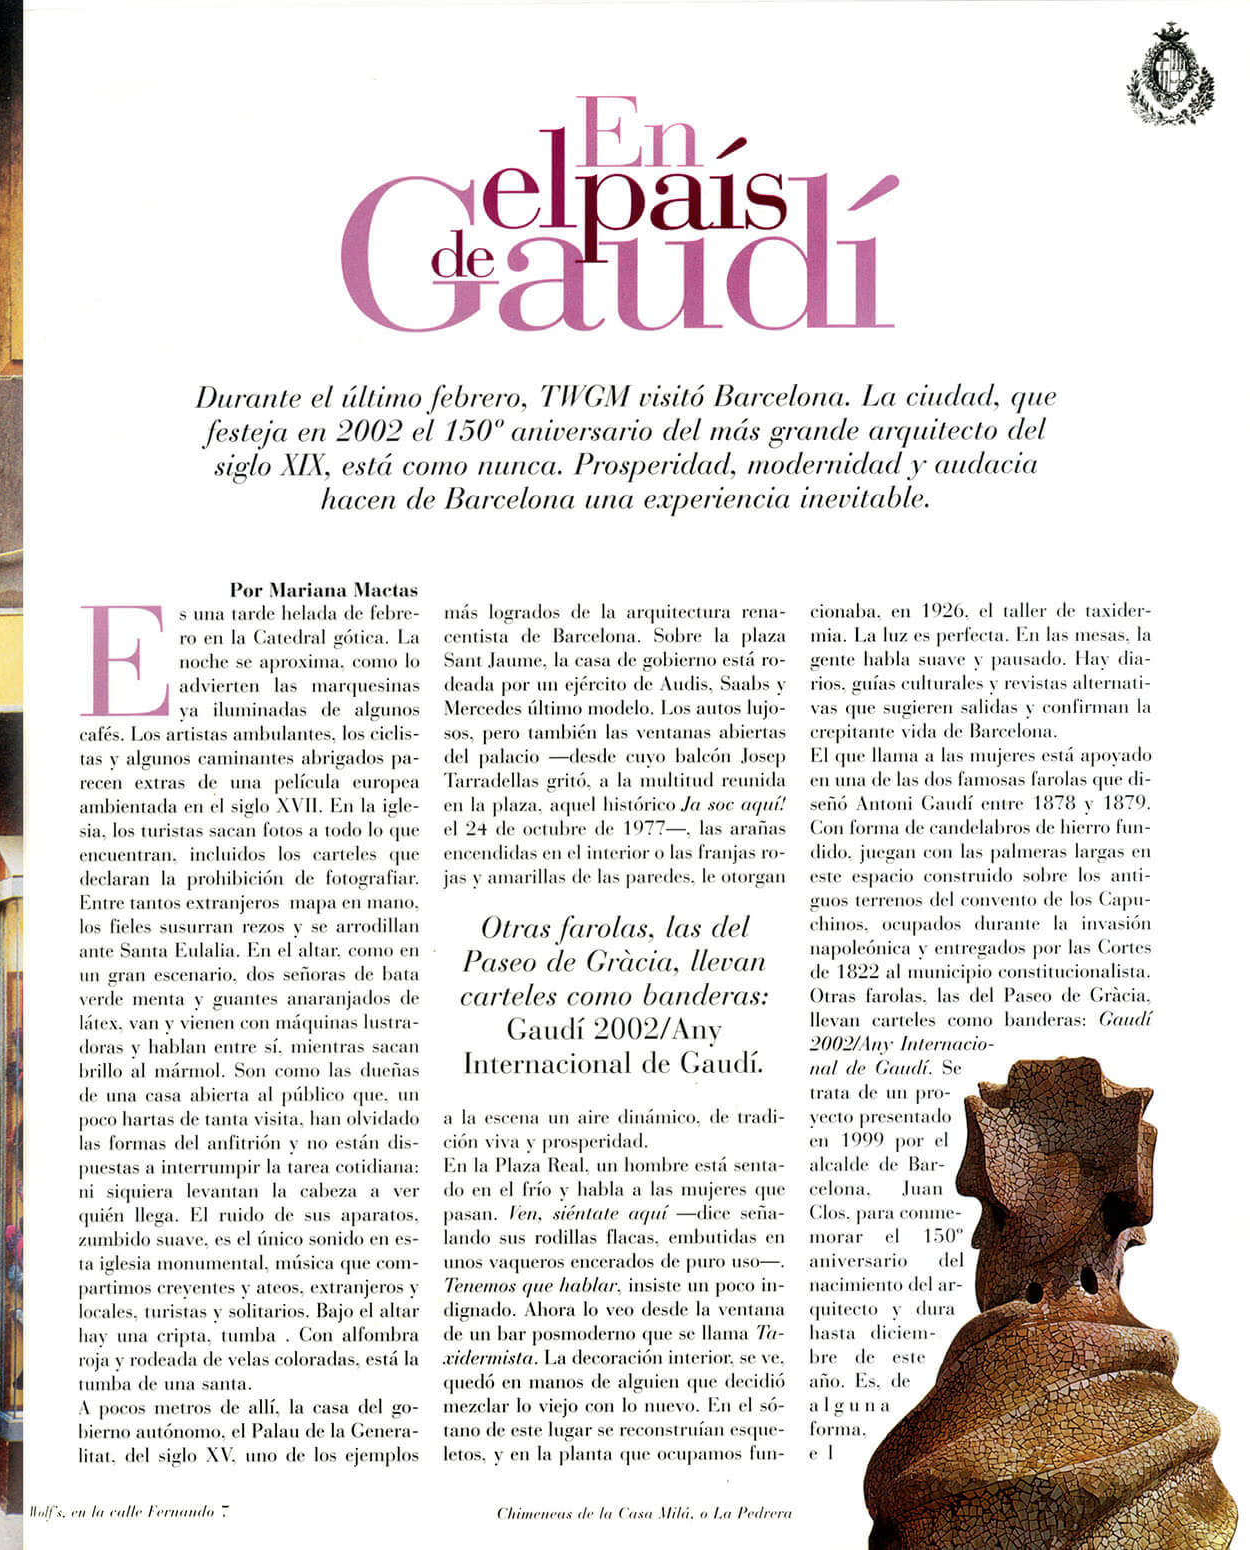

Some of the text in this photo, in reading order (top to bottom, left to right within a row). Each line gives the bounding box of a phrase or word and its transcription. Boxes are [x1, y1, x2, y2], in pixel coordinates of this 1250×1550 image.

[576, 95, 704, 168] En
[341, 172, 900, 332] Gaudí
[431, 230, 495, 278] de
[195, 383, 1057, 415] Durante el último febrero, TWGM visitó Barcelona. La ciudad, que
[201, 418, 287, 450] festeja
[297, 427, 326, 442] en
[335, 418, 403, 441] 2002
[412, 418, 435, 441] el
[511, 418, 653, 441] aniversario
[662, 417, 702, 440] del
[709, 417, 761, 440] más
[768, 417, 860, 448] grande
[868, 417, 998, 448] arquitecto
[1007, 416, 1047, 440] del
[213, 450, 1038, 484] siglo XIX, está como nunca. Prosperidad, modernidad y audacia
[320, 484, 929, 516] hacen de Barcelona una experiencia inevitable.
[230, 581, 419, 597] Por Mariana Mactas
[193, 610, 224, 620] una
[232, 604, 275, 620] tarde
[281, 604, 337, 620] helada
[343, 604, 364, 620] de
[370, 604, 420, 620] febre-
[444, 603, 786, 624] más logrados de la arquitectura rena-
[180, 628, 419, 648] ro en la Catedral gótica. La
[443, 626, 786, 648] centista de Barcelona. Sobre la plaza
[810, 723, 1058, 744] crepitante vida de Barcelona.
[79, 869, 419, 890] declaran la prohibición de fotografiar.
[481, 914, 751, 945] Otras farolas, las del
[463, 948, 765, 973] Paseo de Gràcia, llevan
[810, 963, 1151, 983] de 1822 al municipio constitucionalista.
[460, 982, 769, 1006] carteles como banderas:
[507, 1016, 722, 1047] Gaudí 2002/Any
[465, 1050, 763, 1074] Internacional de Gaudí.
[443, 1132, 648, 1153] ción viva y prosperidad.
[809, 1131, 948, 1152] en 1999 por el
[809, 1155, 945, 1171] alcalde de Bar-
[443, 1300, 785, 1321] dignado. Ahora lo veo desde la ventana
[78, 1375, 252, 1391] tumba de una santa.
[497, 1506, 573, 1519] Chimeneas
[577, 1506, 594, 1519] de
[599, 1506, 613, 1519] la
[618, 1507, 653, 1519] Casa
[658, 1506, 694, 1519] Milá,
[713, 1506, 732, 1519] La
[737, 1505, 792, 1519] Pedrera
